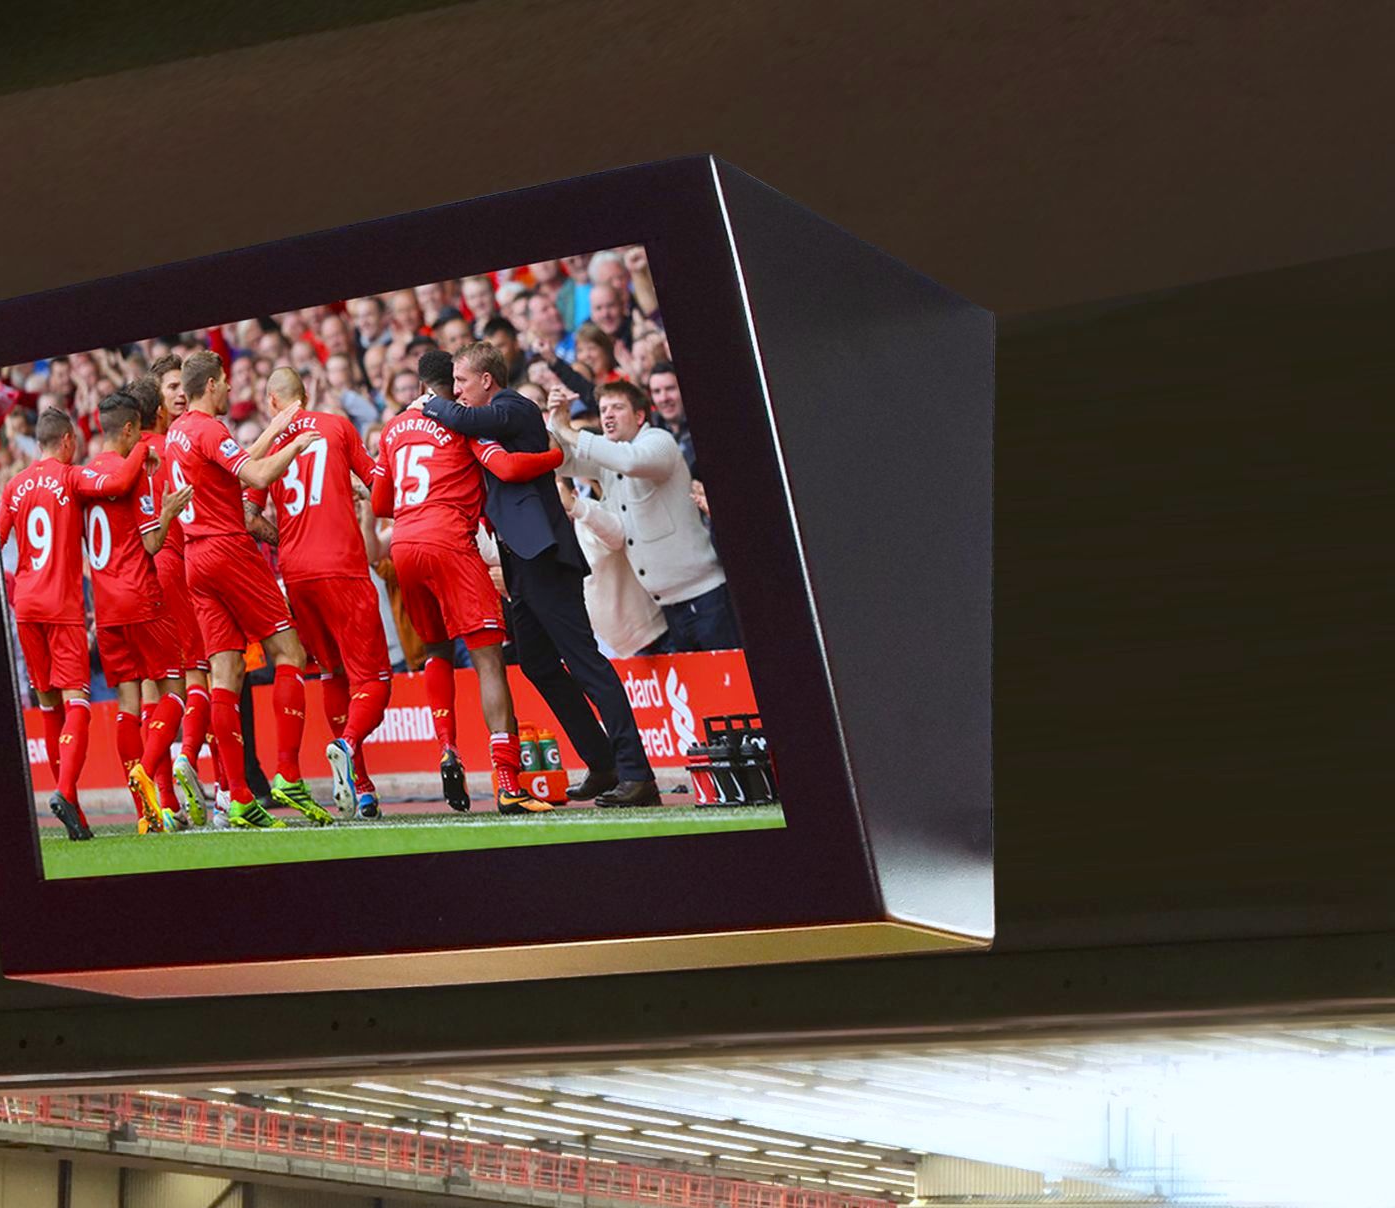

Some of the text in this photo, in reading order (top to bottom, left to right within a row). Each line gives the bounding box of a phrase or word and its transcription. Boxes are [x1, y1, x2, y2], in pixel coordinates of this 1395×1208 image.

[385, 418, 453, 446] STURRIDGE
[9, 475, 71, 513] IAGO ASPAS
[283, 437, 328, 517] 37
[393, 443, 436, 509] 15
[27, 506, 53, 571] 9
[84, 505, 112, 571] 0
[363, 705, 438, 744] ARRIO
